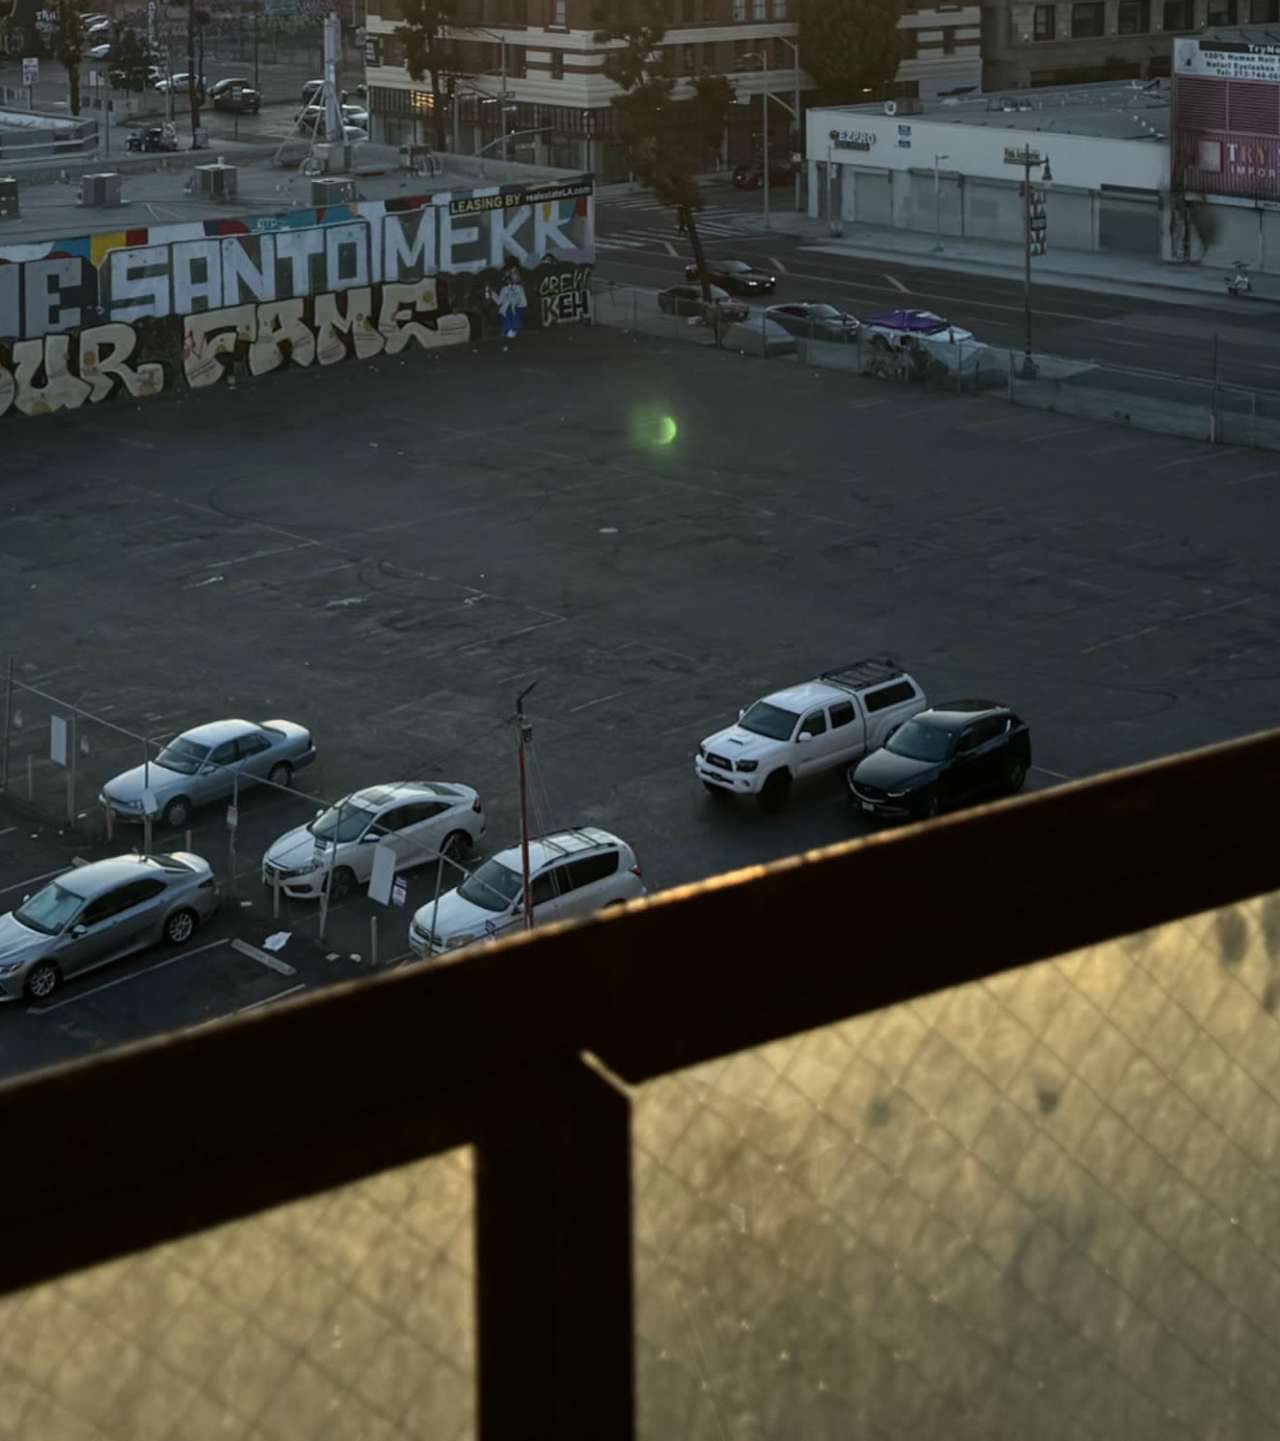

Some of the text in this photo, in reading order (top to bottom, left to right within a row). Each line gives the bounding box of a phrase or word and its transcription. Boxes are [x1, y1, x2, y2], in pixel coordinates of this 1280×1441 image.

[450, 195, 503, 215] LEASING
[504, 192, 522, 207] BY
[182, 277, 472, 390] FAME
